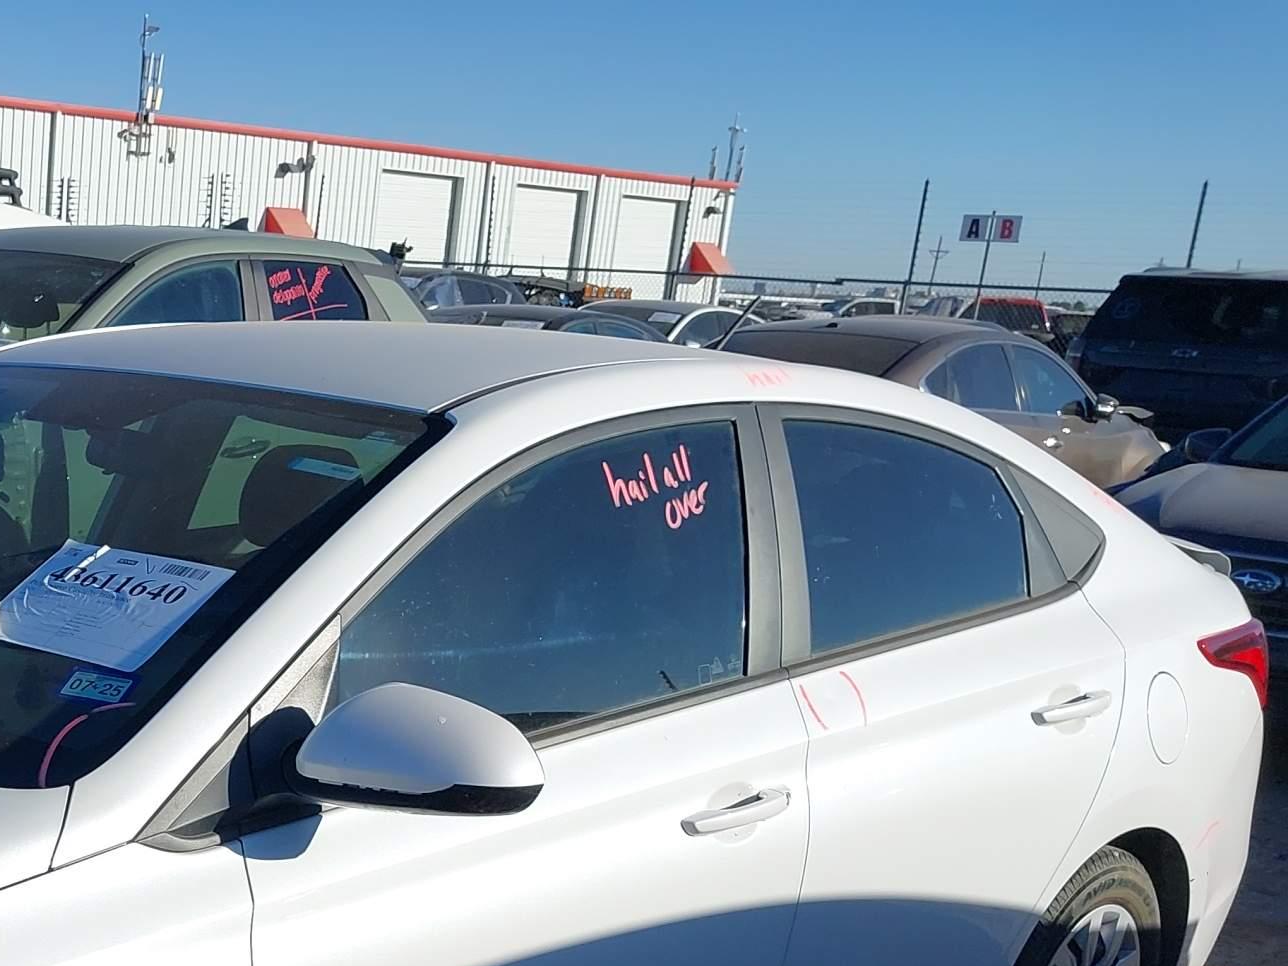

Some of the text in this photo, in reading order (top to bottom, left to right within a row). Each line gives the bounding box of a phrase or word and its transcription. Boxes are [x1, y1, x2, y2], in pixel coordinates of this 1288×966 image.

[966, 218, 1014, 239] A B
[601, 444, 692, 508] hail all
[664, 480, 709, 529] over
[49, 564, 188, 605] 43611640
